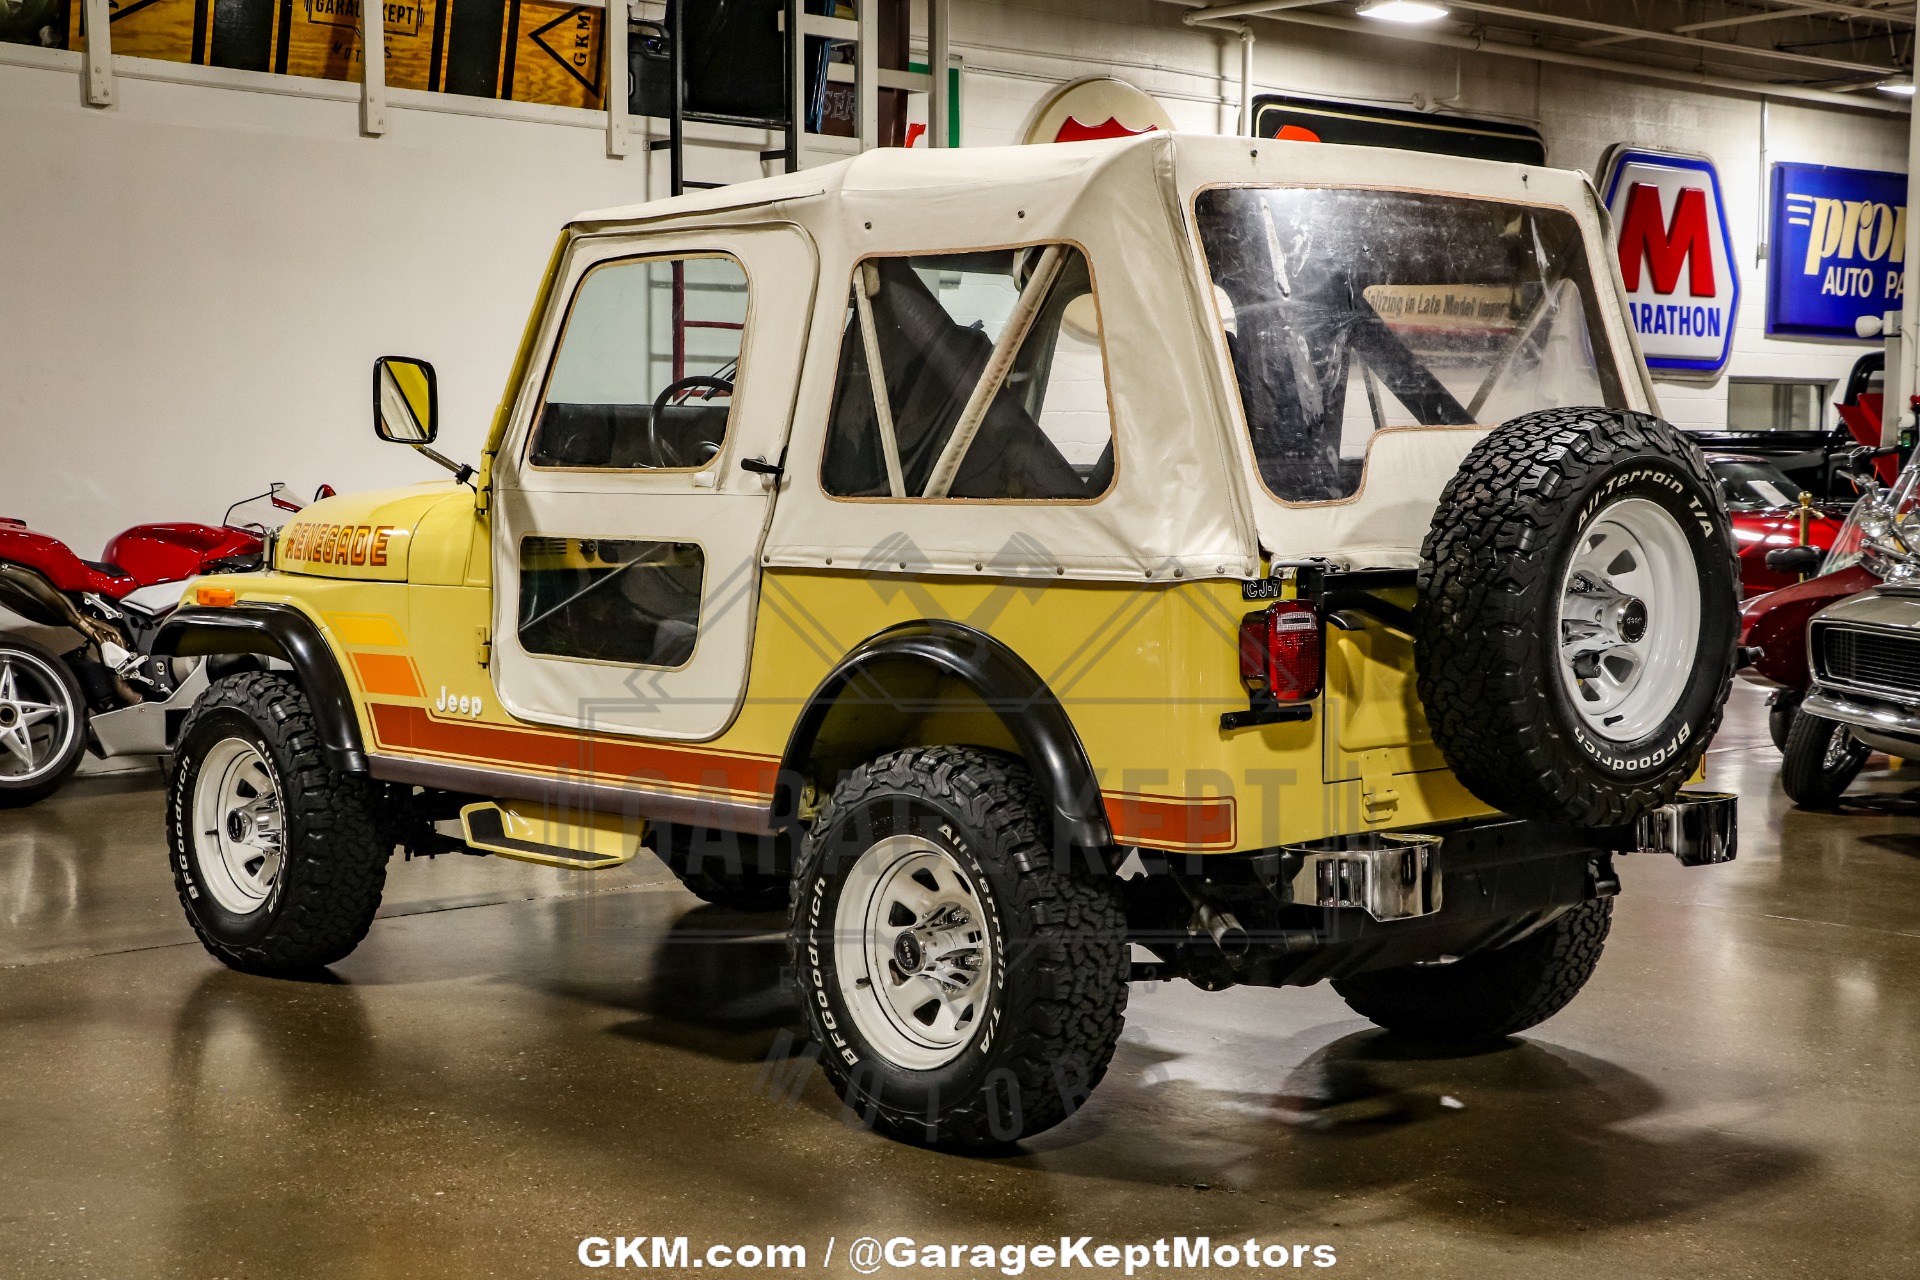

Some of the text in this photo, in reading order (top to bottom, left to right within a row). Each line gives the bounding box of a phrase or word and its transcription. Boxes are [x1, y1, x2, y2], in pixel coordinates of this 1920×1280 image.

[315, 0, 361, 17] GARA
[331, 40, 392, 63] MOTS
[573, 13, 592, 67] GKM
[1617, 181, 1717, 298] M
[1821, 265, 1874, 298] AUTO
[1417, 293, 1441, 315] Late
[1443, 293, 1477, 317] Model
[1629, 302, 1721, 338] ARATHON
[1577, 469, 1715, 538] All-Terrain T/A
[284, 522, 395, 567] RENEGADE
[1246, 579, 1281, 598] CJ-7
[436, 685, 483, 719] Jeep
[1574, 721, 1692, 771] BFGoodrich
[174, 755, 200, 900] BFGoodrich
[937, 823, 1007, 1055] All-Terrain T/A
[807, 876, 860, 1067] BFGoodrich
